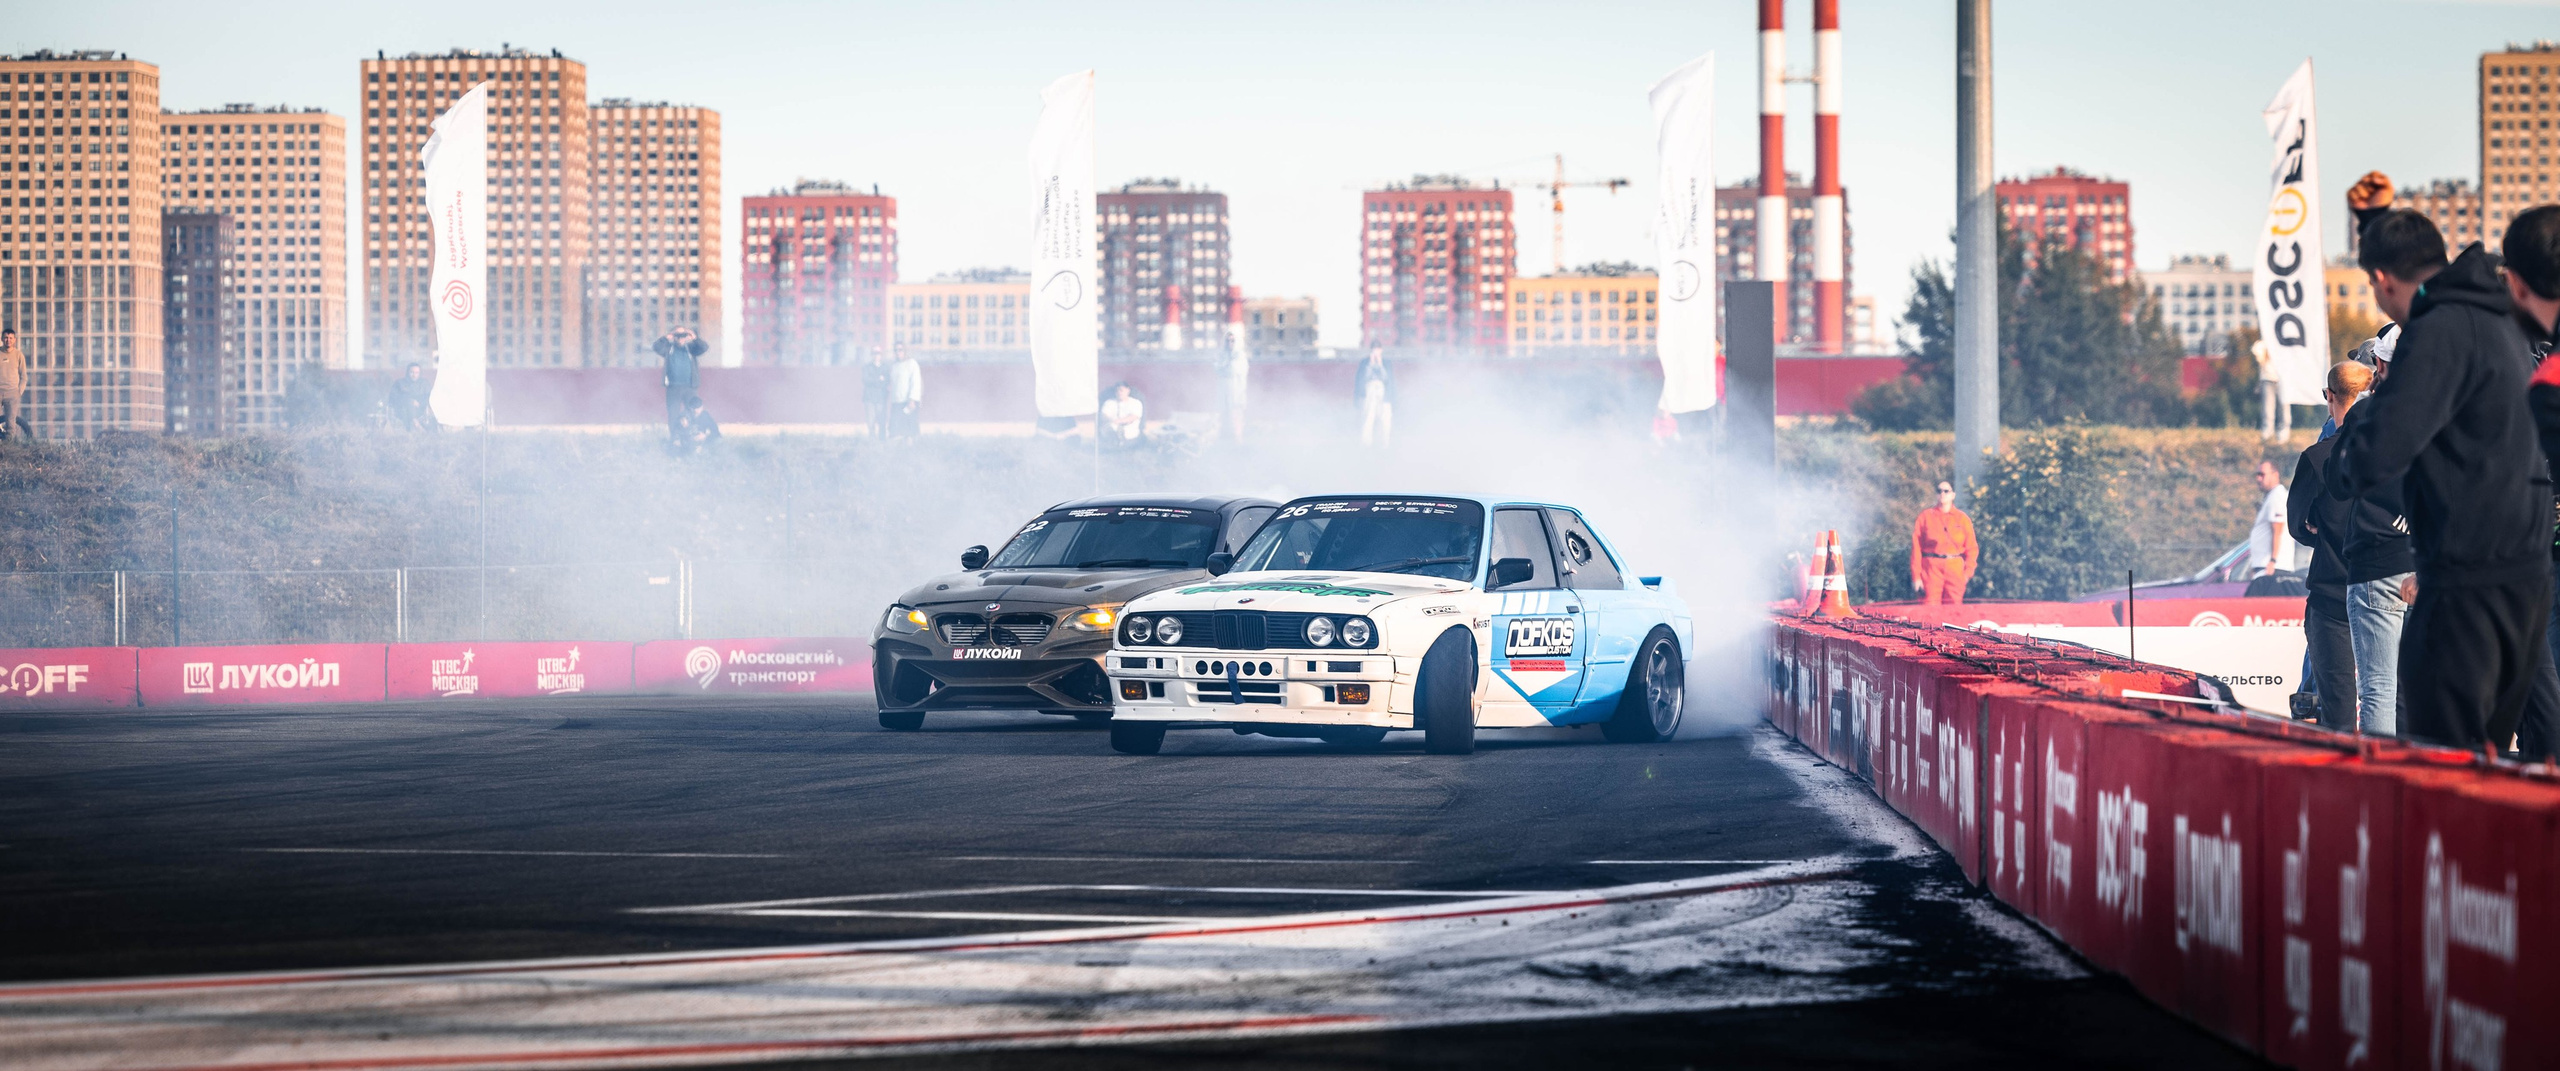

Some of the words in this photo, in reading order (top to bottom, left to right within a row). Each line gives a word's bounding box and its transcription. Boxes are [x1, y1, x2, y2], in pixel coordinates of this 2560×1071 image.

[1276, 503, 1313, 520] 26
[1020, 520, 1049, 535] 22
[2392, 514, 2410, 535] IN
[728, 649, 834, 665] Московский
[965, 646, 1022, 660] ЛУКОЙЛ
[432, 659, 461, 674] ЦТВС
[537, 658, 567, 673] ЦТВС
[219, 658, 339, 690] ЛУКОЙЛ
[537, 674, 584, 689] МОСКВА
[728, 671, 816, 685] транспорт
[432, 675, 478, 691] МОСКВА
